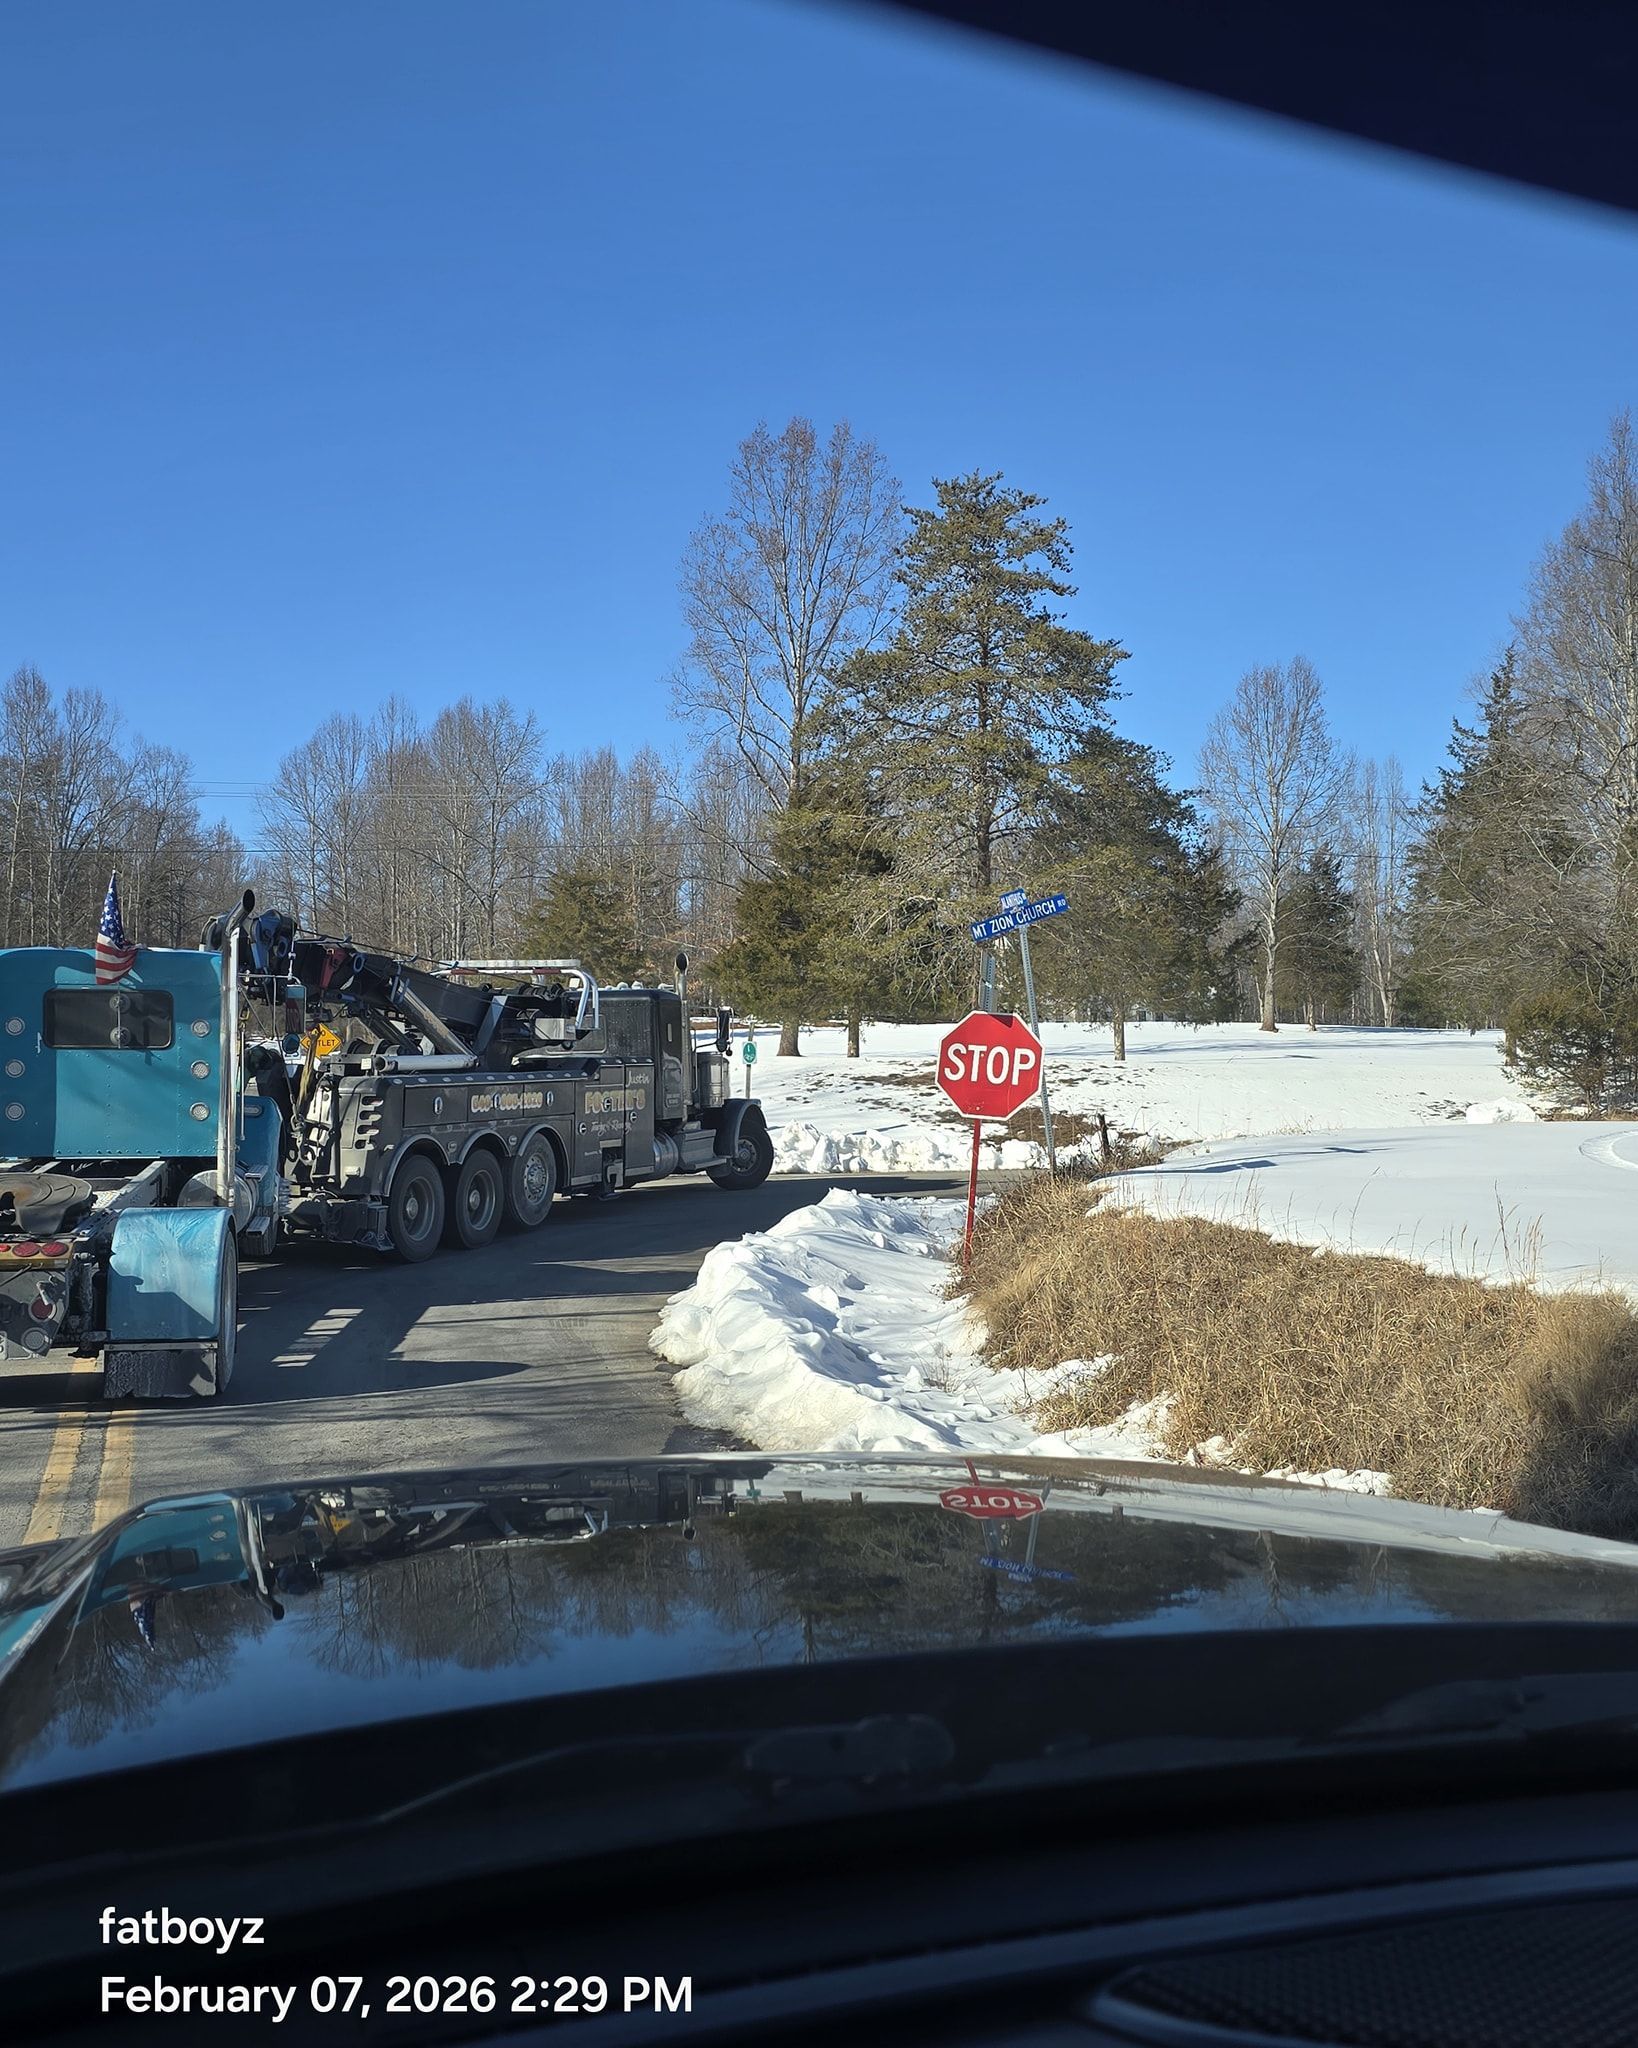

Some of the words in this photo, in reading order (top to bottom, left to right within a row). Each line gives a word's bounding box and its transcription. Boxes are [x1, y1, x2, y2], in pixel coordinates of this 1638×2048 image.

[972, 923, 987, 940] MT
[989, 913, 1014, 934] ZION
[1016, 900, 1057, 924] CHURCH
[944, 1043, 1036, 1086] STOP
